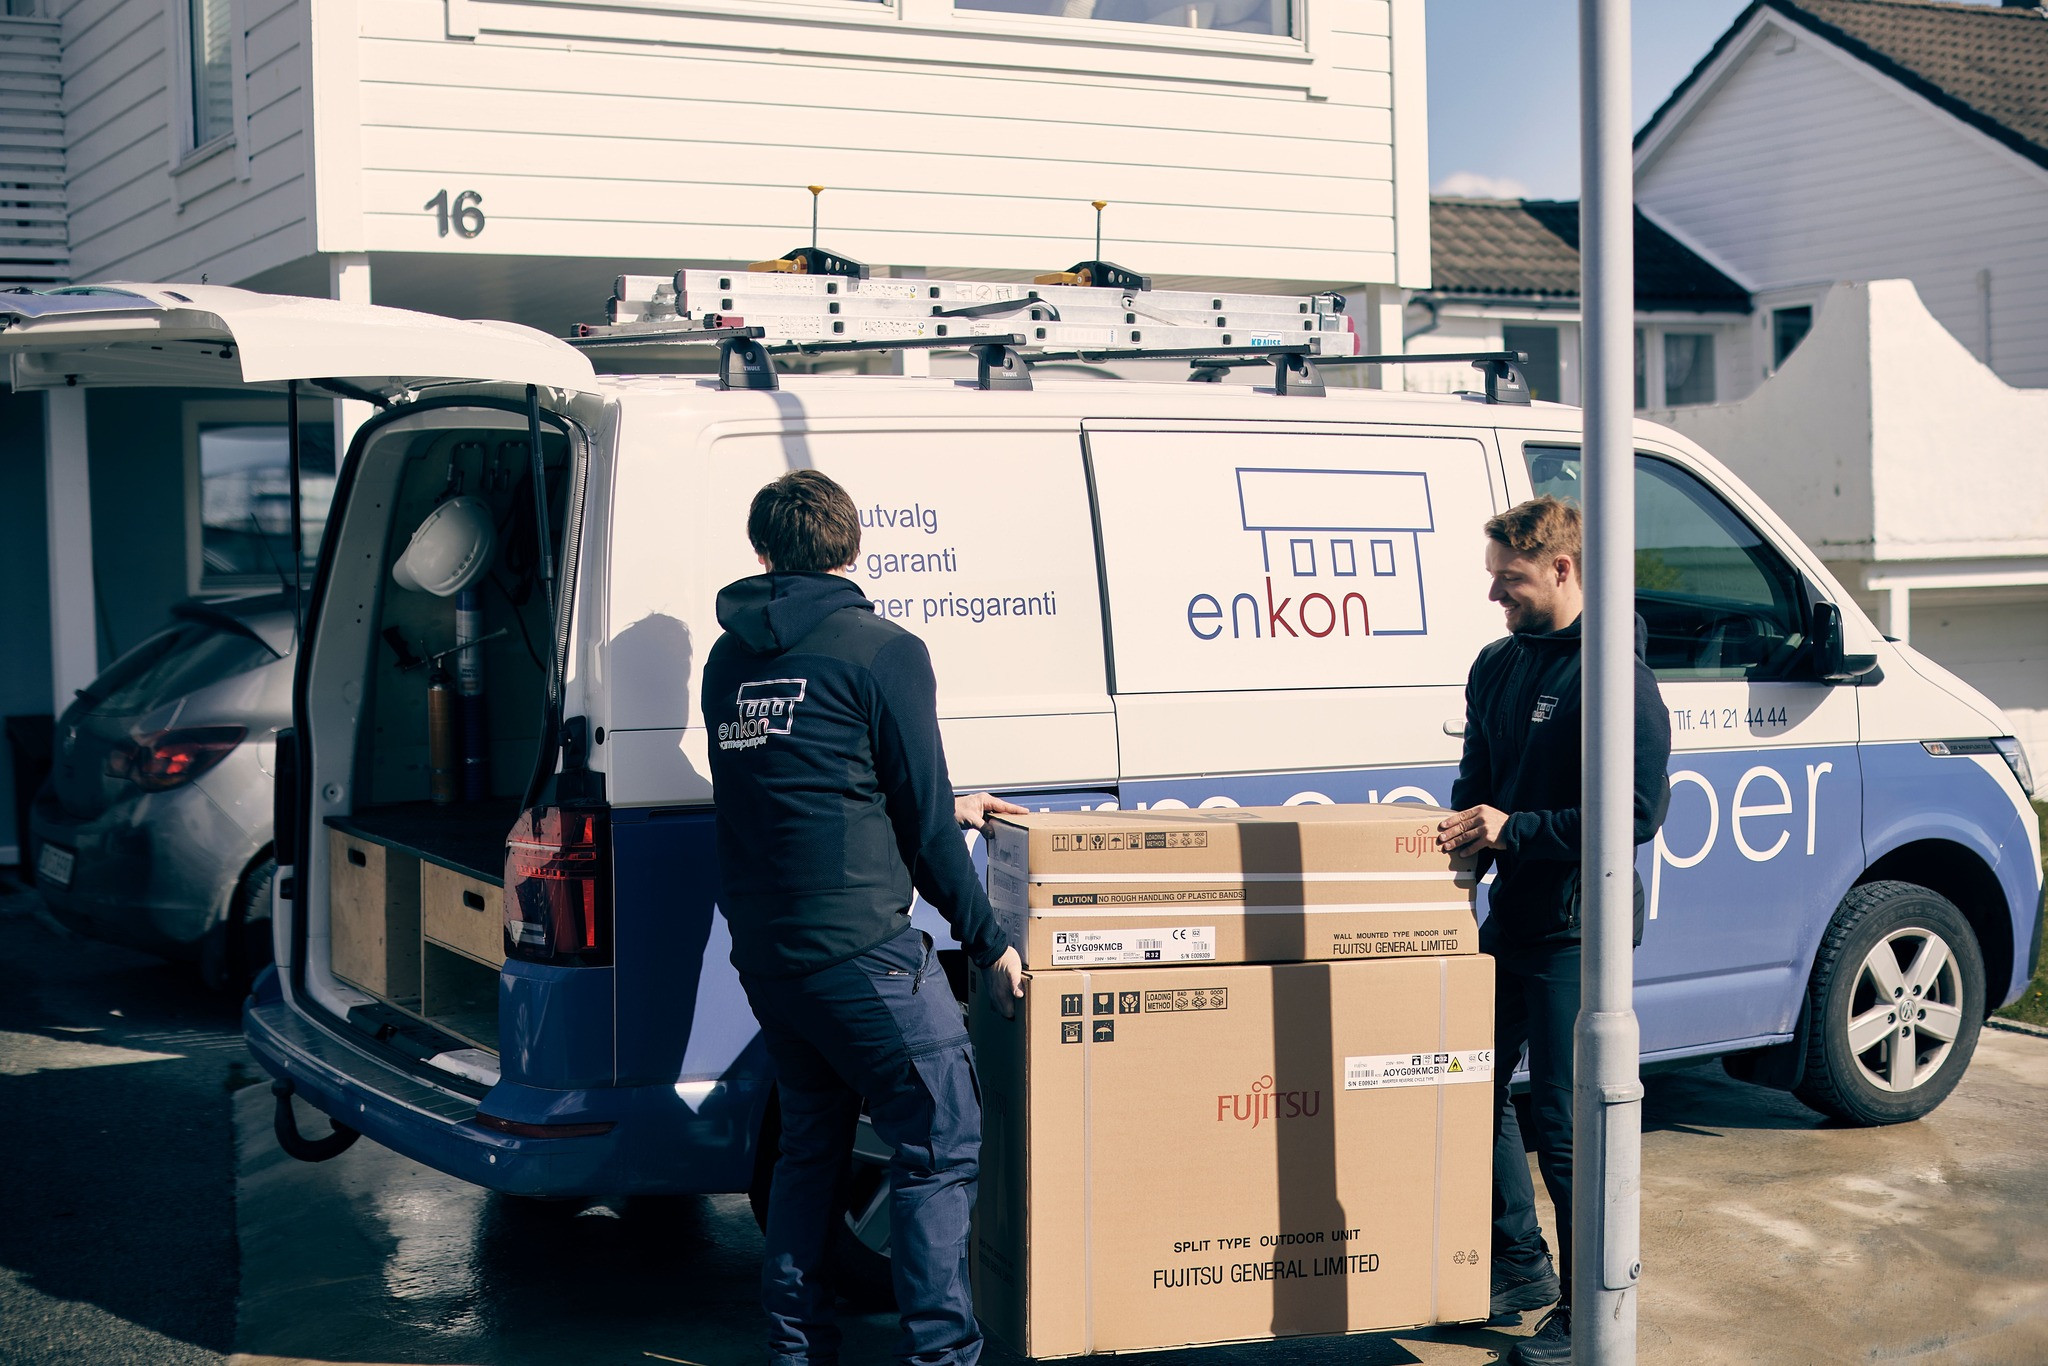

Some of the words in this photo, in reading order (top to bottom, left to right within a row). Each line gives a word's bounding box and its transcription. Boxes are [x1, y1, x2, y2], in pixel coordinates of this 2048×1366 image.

[424, 189, 485, 238] 16
[859, 503, 938, 534] utvalg
[867, 548, 957, 579] garanti
[923, 591, 1057, 623] prisgaranti
[1187, 576, 1370, 640] enkon
[718, 717, 769, 741] enkon
[1674, 709, 1695, 730] Tlf.
[1700, 709, 1717, 729] 41
[1723, 709, 1738, 728] 21
[1744, 707, 1764, 727] 44
[1768, 706, 1787, 726] 44
[1395, 836, 1445, 858] FUJIT
[1058, 896, 1092, 904] CAUTION
[1099, 895, 1109, 903] NO
[1111, 894, 1136, 902] ROUGH
[1138, 893, 1174, 902] HANDLING
[1188, 892, 1217, 900] PLASTIC
[1219, 891, 1245, 899] BANDS.
[1065, 943, 1123, 952] ASYG09KMCB
[1333, 943, 1372, 955] FUJITSU
[1375, 941, 1418, 953] GENERAL
[1421, 939, 1458, 951] LIMITED
[1147, 993, 1171, 1001] LOADING
[1383, 1066, 1445, 1077] AOYG09KMCBN
[1217, 1090, 1320, 1129] FUJITSU
[1173, 1240, 1210, 1253] SPLIT
[1217, 1237, 1251, 1250] TYPE
[1260, 1232, 1324, 1247] OUTDOOR
[1331, 1229, 1361, 1241] UNIT
[1153, 1264, 1223, 1289] FUJITSU
[1231, 1259, 1307, 1283] GENERAL
[1314, 1253, 1379, 1277] LIMITED
